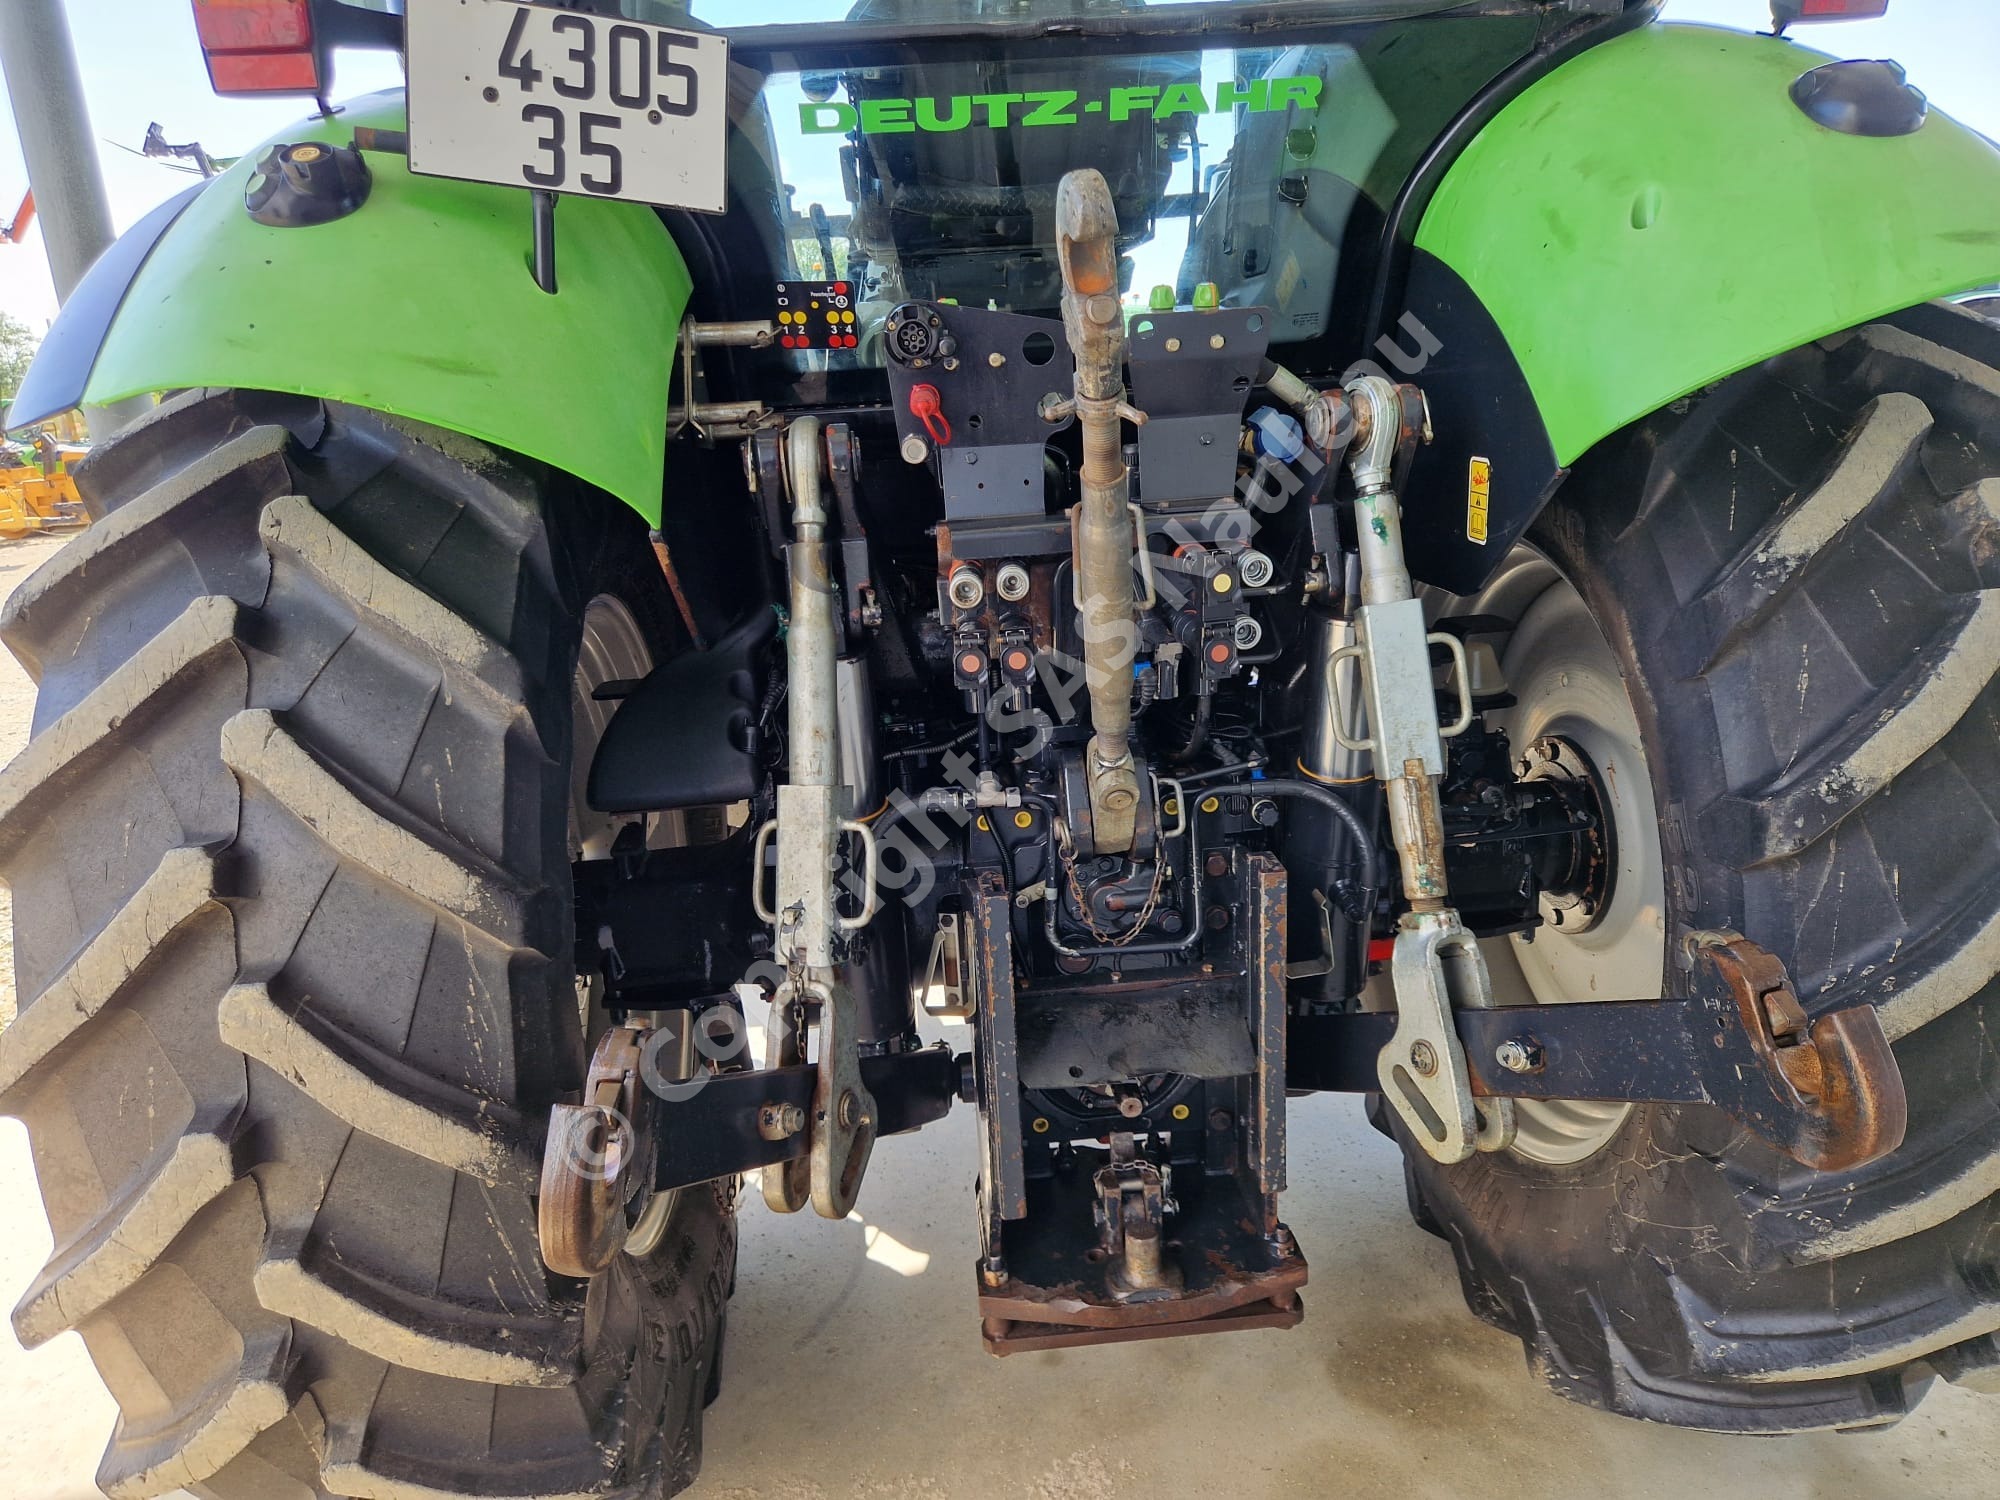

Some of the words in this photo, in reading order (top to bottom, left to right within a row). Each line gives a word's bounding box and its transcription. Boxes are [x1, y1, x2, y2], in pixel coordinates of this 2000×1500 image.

[498, 7, 699, 118] 4305
[799, 75, 1324, 135] DEUTZ-FAHR
[522, 104, 623, 196] 35
[783, 325, 789, 334] 1
[798, 325, 805, 334] 2
[831, 325, 838, 334] 3
[845, 325, 852, 334] 4
